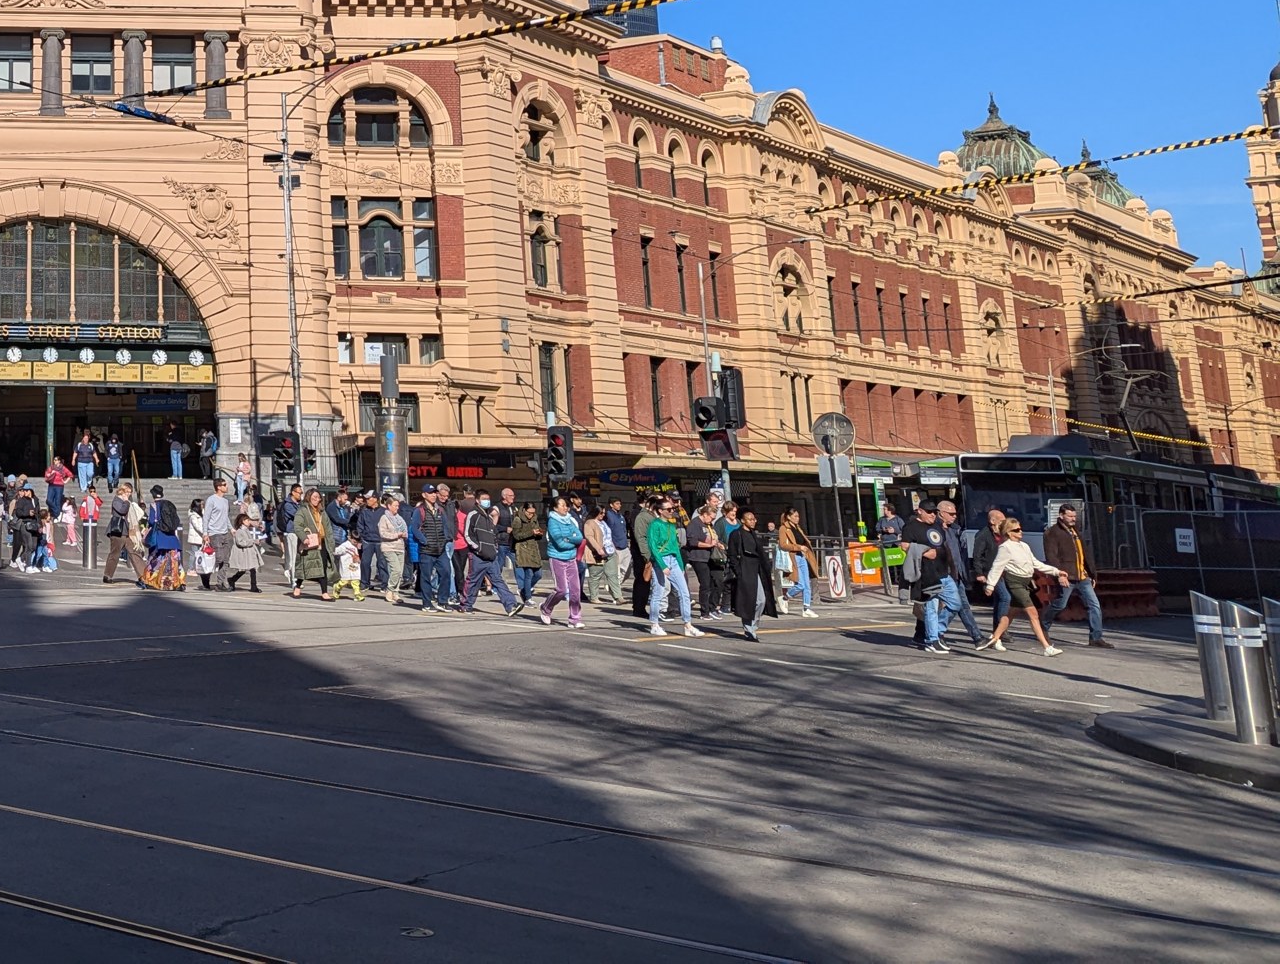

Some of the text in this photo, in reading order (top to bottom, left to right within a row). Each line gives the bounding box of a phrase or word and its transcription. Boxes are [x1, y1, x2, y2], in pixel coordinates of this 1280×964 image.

[27, 325, 81, 338] STREET
[98, 326, 162, 339] STATION
[141, 397, 187, 405] Customer Service
[407, 465, 485, 478] CITY HATTERS
